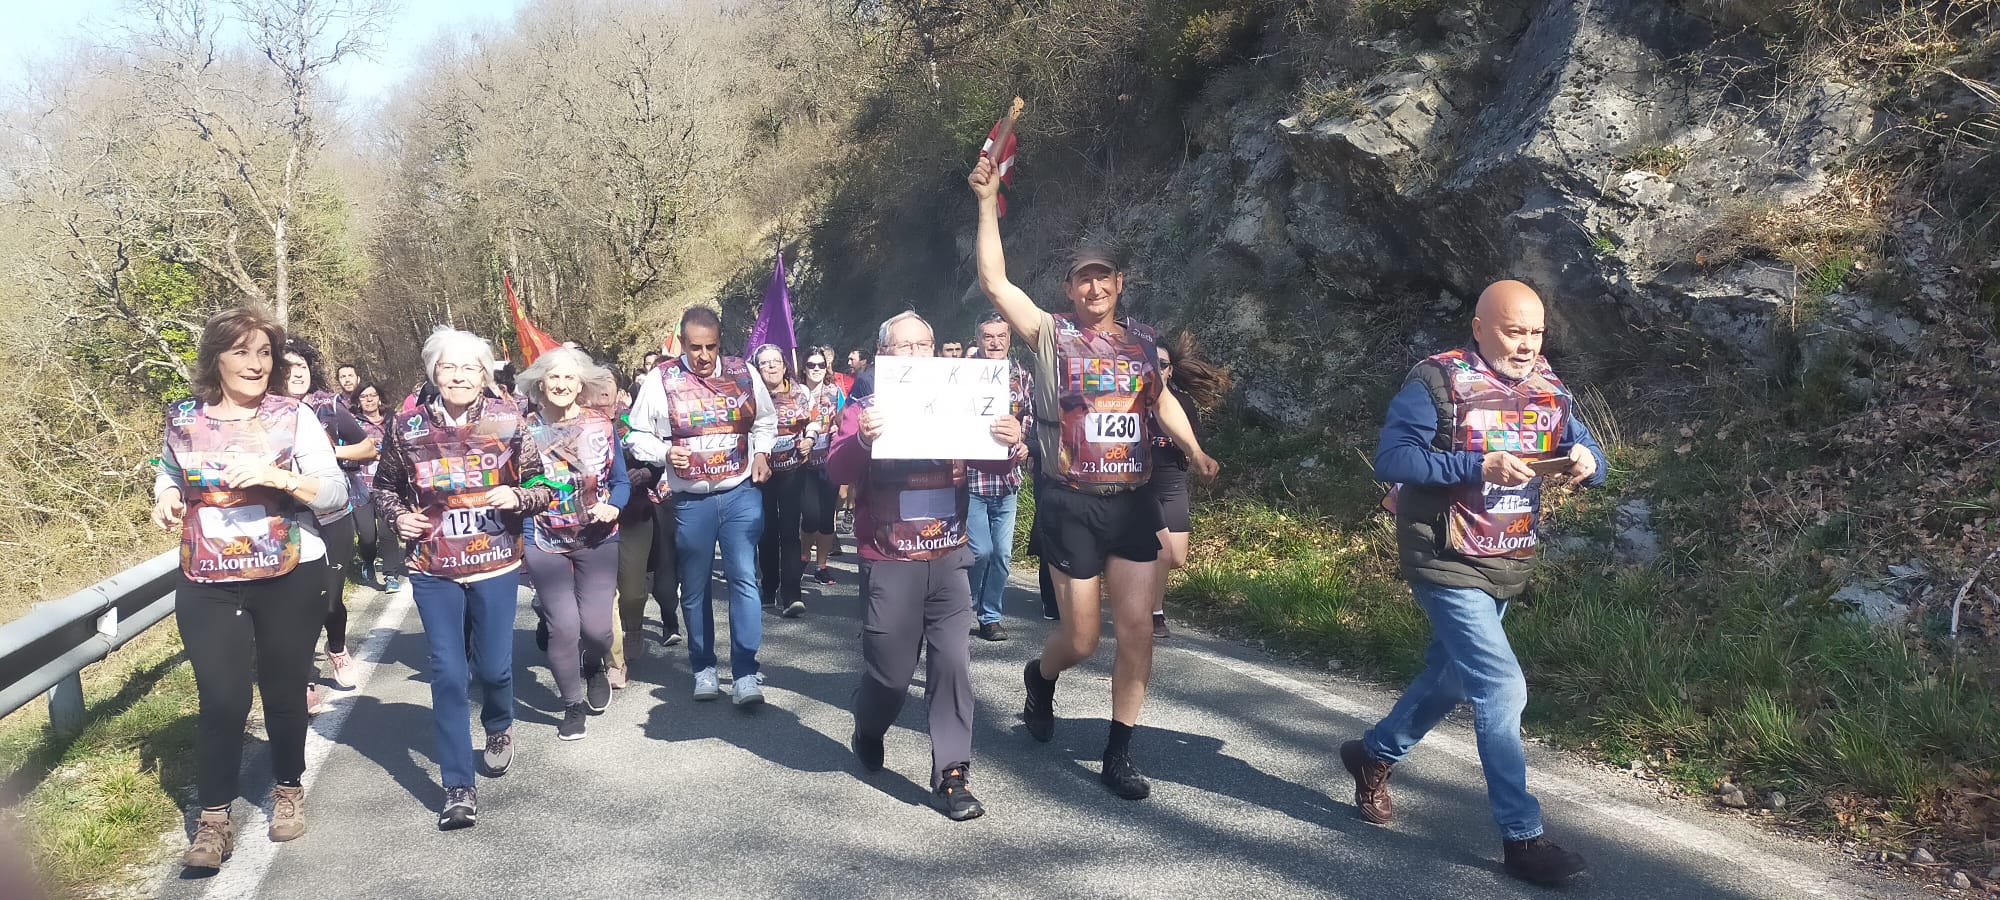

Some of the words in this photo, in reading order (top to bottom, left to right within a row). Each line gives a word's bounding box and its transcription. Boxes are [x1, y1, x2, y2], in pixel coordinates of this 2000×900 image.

[1068, 374, 1144, 392] HERRI
[1094, 414, 1136, 439] 1230
[707, 449, 726, 464] aek
[1105, 444, 1129, 459] aek
[690, 459, 740, 475] 23.korrika
[1506, 515, 1531, 534] aek
[222, 541, 252, 556] aek
[465, 534, 491, 553] aek
[199, 552, 280, 572] 23.korrika
[441, 545, 513, 568] 23.korrika
